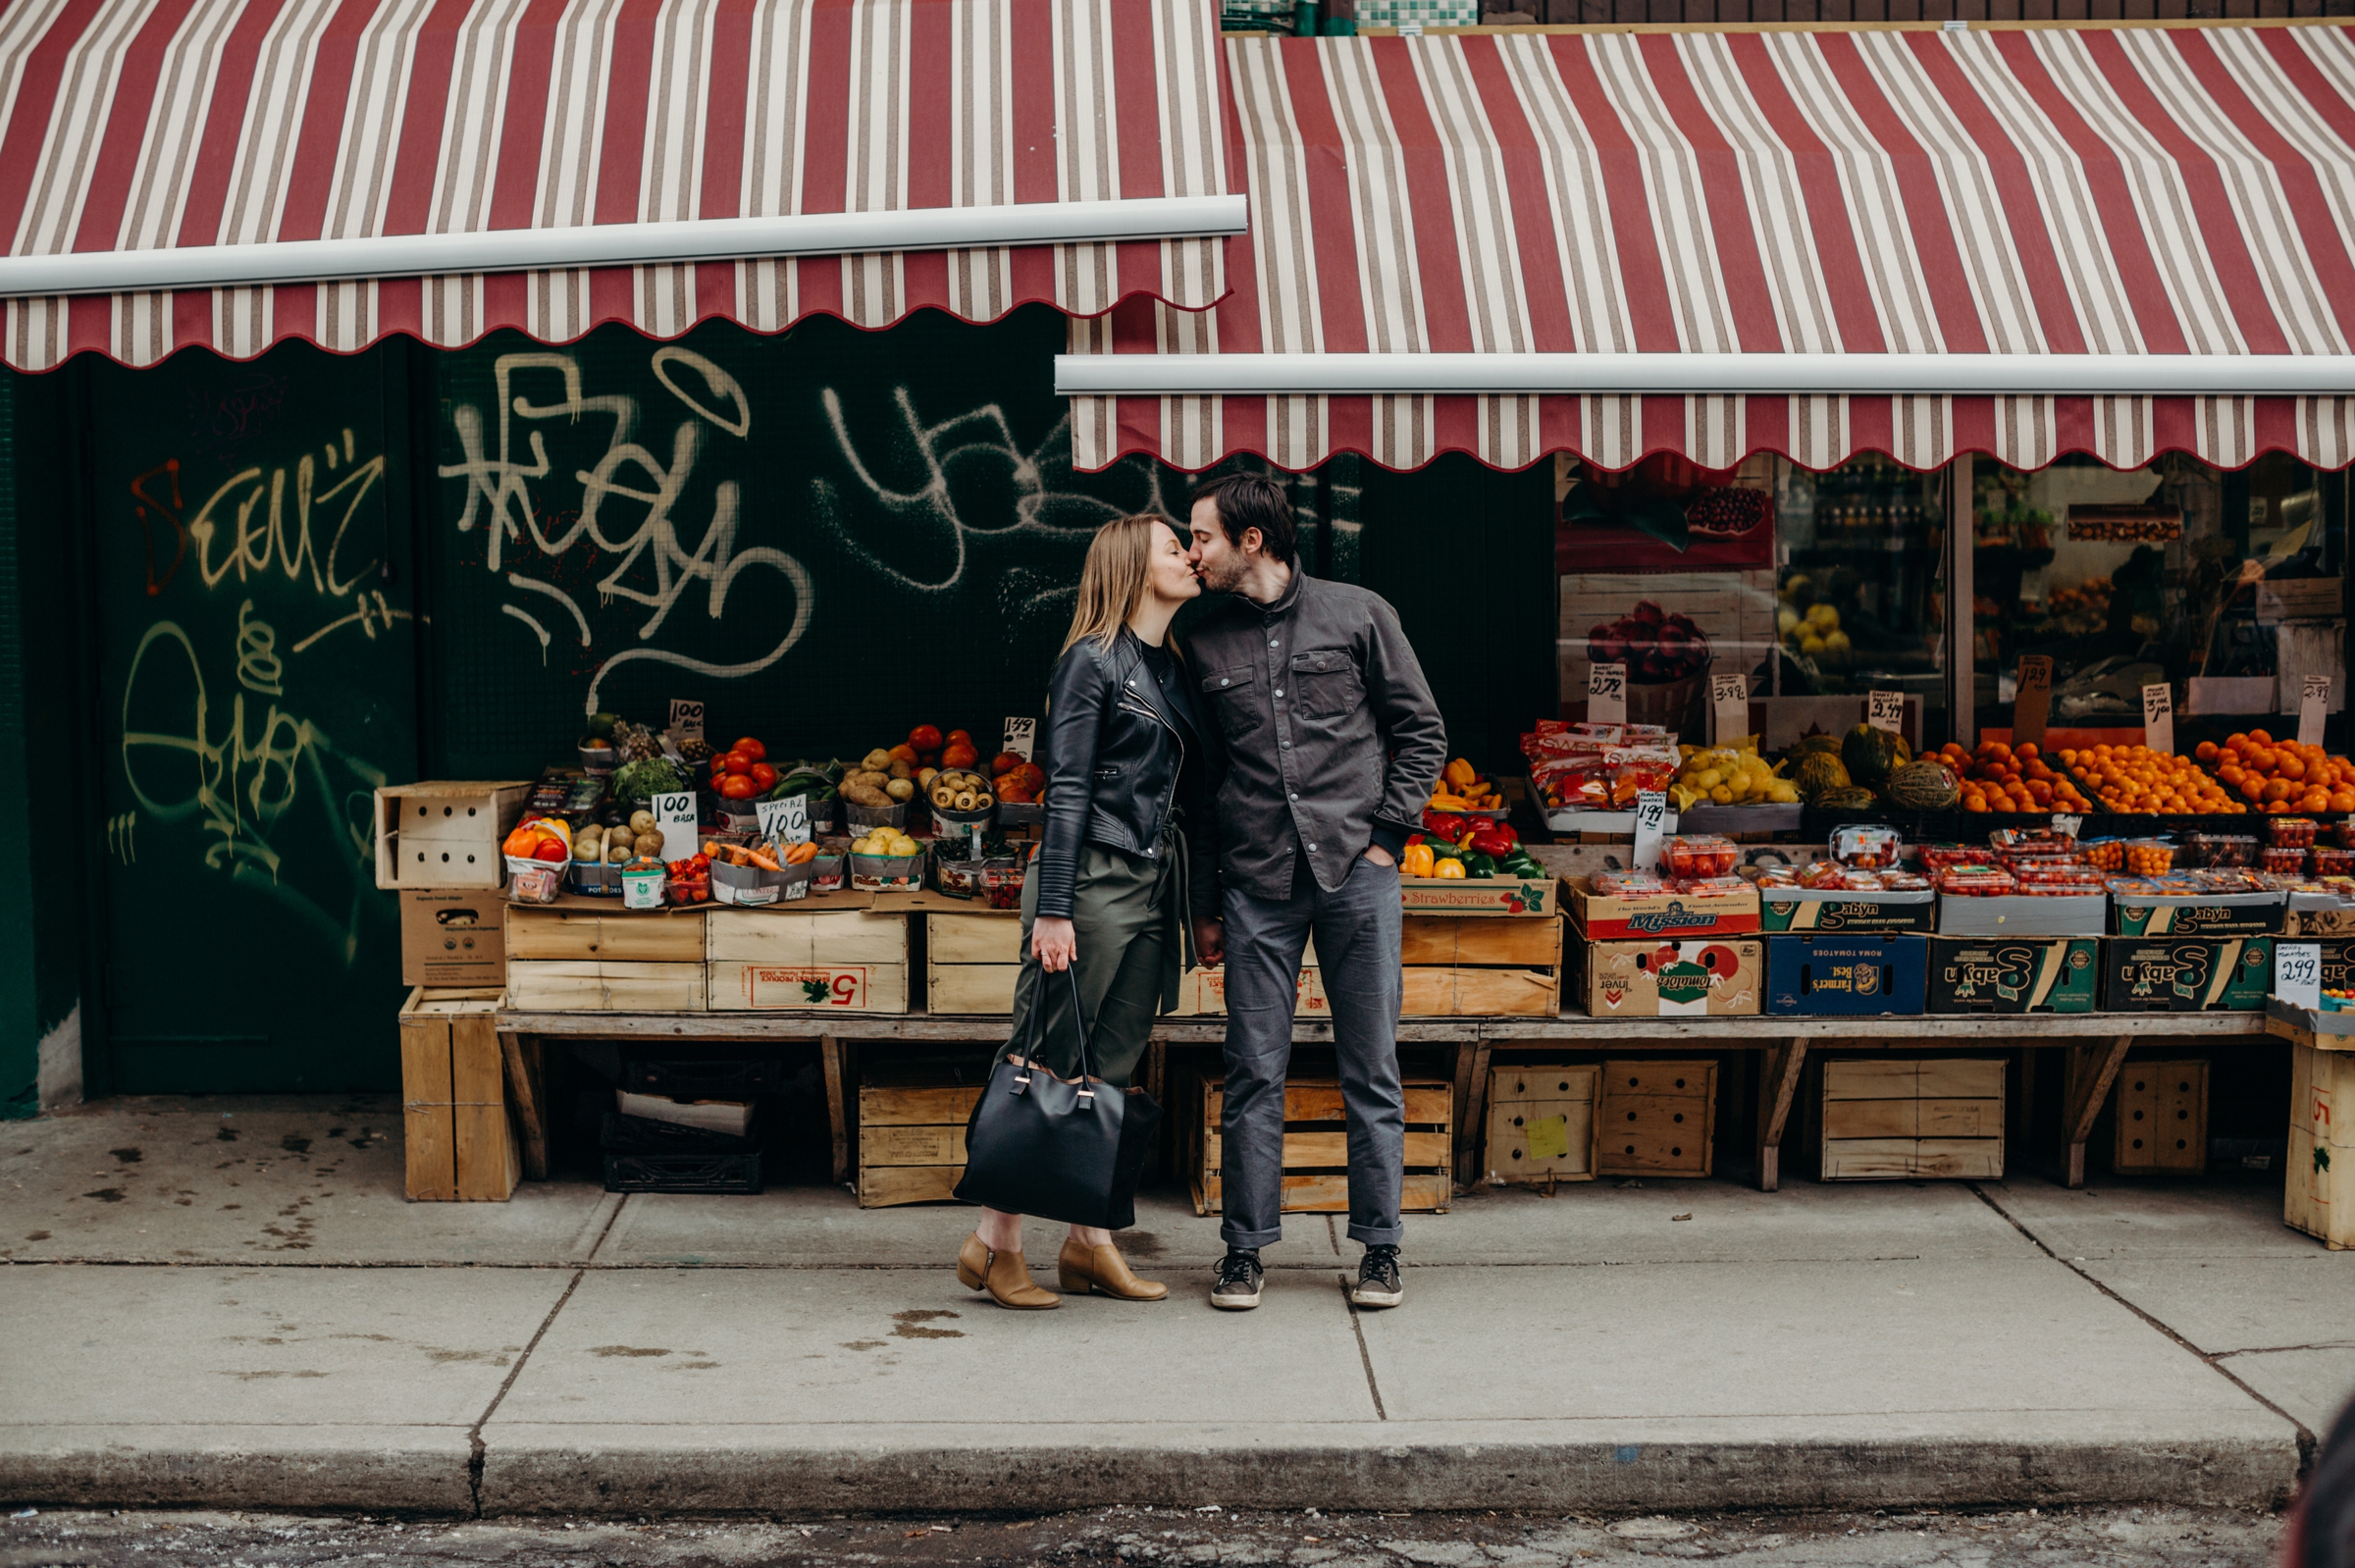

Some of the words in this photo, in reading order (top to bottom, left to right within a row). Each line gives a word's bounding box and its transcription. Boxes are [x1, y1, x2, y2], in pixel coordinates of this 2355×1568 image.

[2146, 699, 2156, 711] 3
[589, 885, 622, 894] POTOES
[1410, 891, 1495, 906] Strawberries
[1819, 901, 1879, 928] gabyn
[2173, 906, 2231, 933] gabyn
[1626, 912, 1719, 933] Mission
[1833, 967, 1853, 978] Best
[831, 974, 858, 1006] 5
[1656, 975, 1713, 991] tomatoes
[1812, 979, 1852, 992] Farmer's
